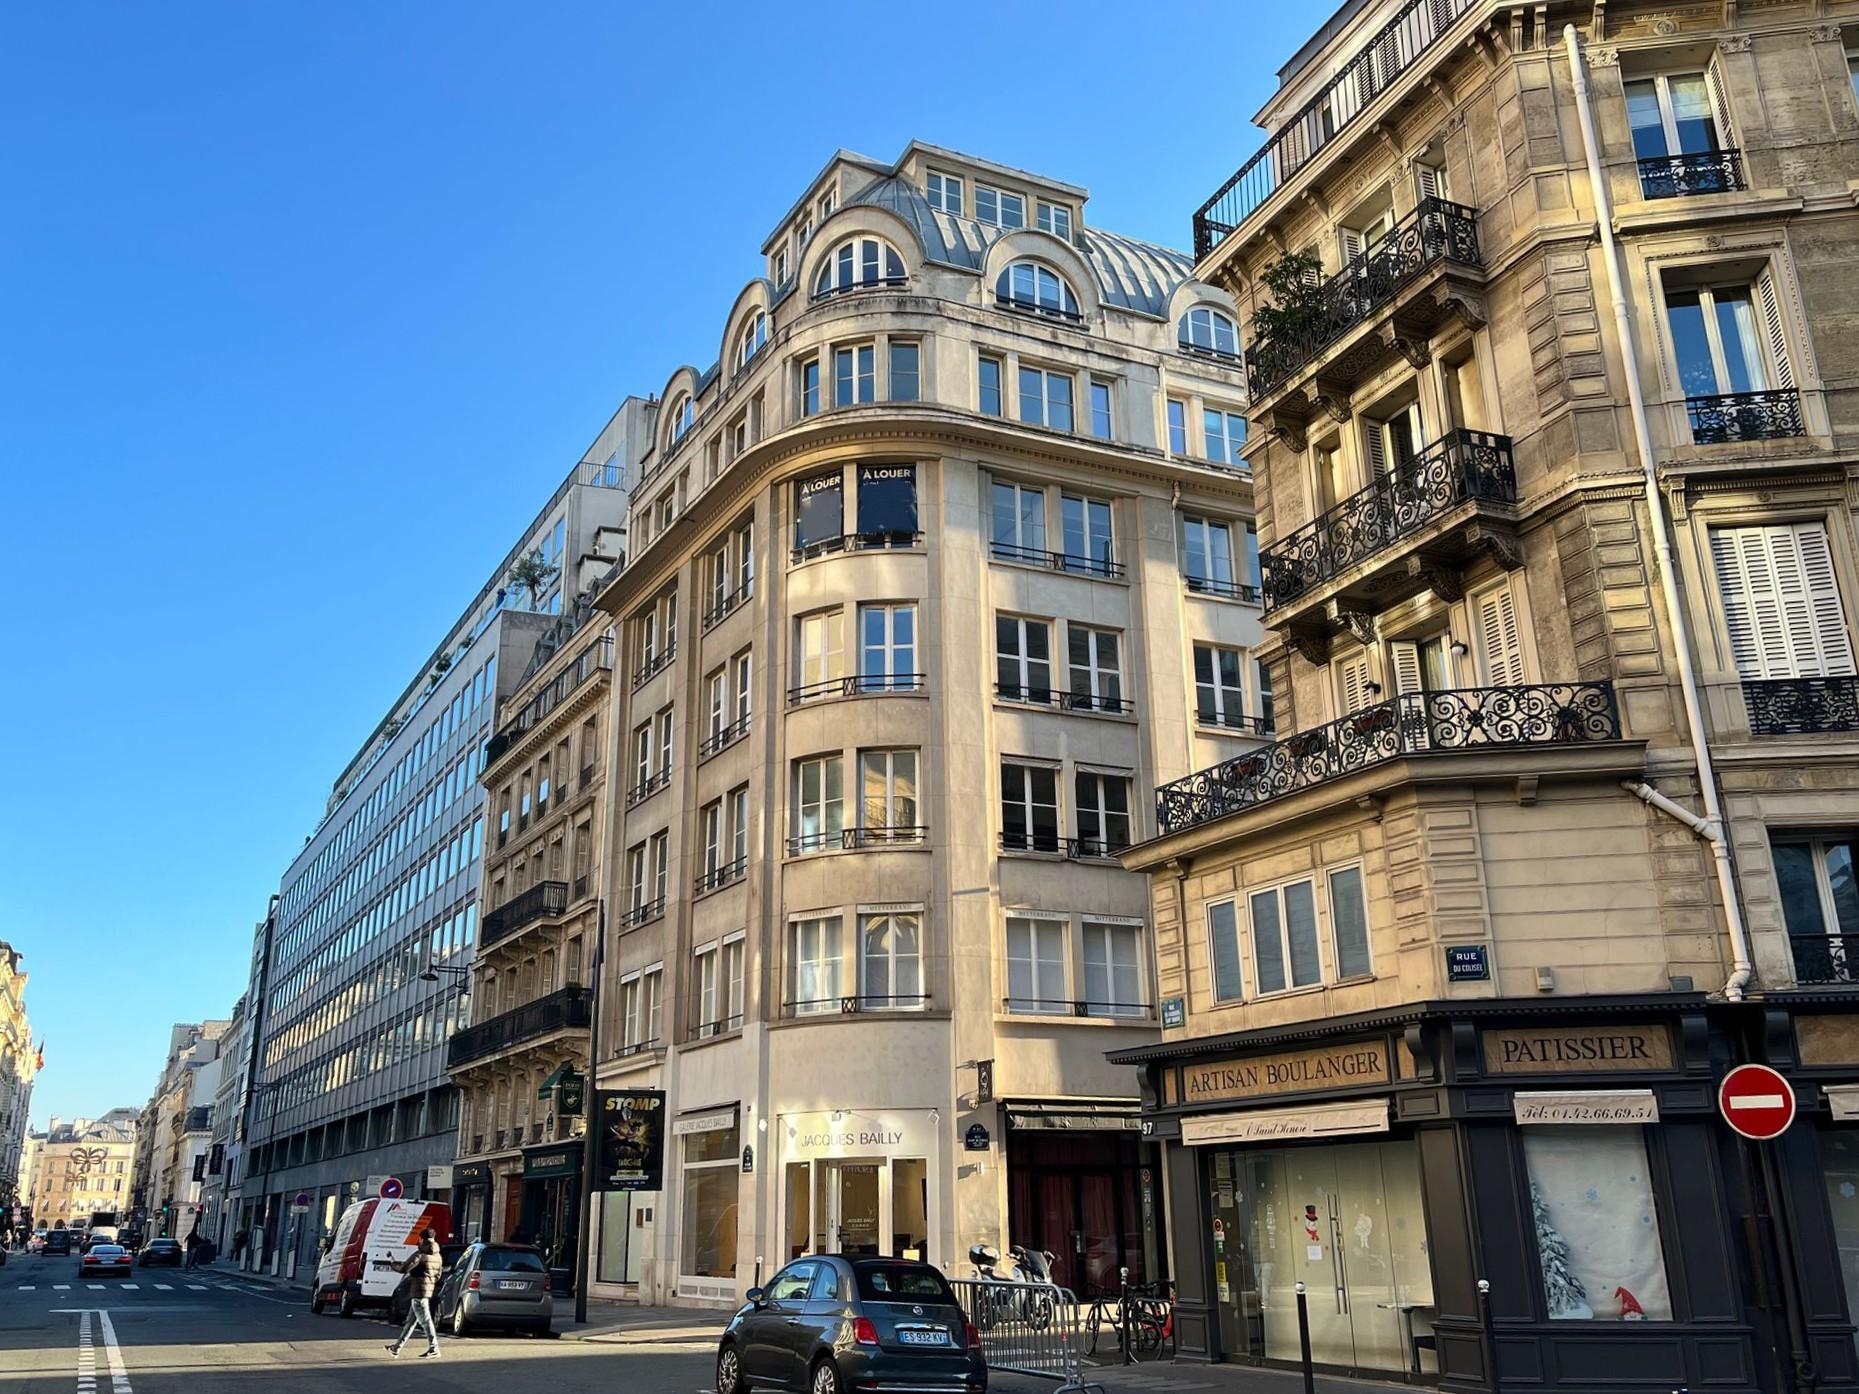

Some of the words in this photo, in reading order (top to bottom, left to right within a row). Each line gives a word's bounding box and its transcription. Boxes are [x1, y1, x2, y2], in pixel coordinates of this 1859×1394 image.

[863, 469, 872, 480] À
[873, 469, 911, 479] LOUER
[801, 483, 810, 494] À
[810, 476, 841, 492] LOUER
[1456, 952, 1477, 961] RUE
[1453, 964, 1461, 973] DU
[1501, 1036, 1652, 1063] PATISSIER
[1190, 1066, 1258, 1094] ARTISAN
[1266, 1051, 1382, 1085] BOULANGER
[605, 1097, 660, 1111] STOMP
[1142, 1121, 1153, 1135] 97
[802, 1133, 854, 1147] JACQUES
[860, 1132, 902, 1145] BAILLY
